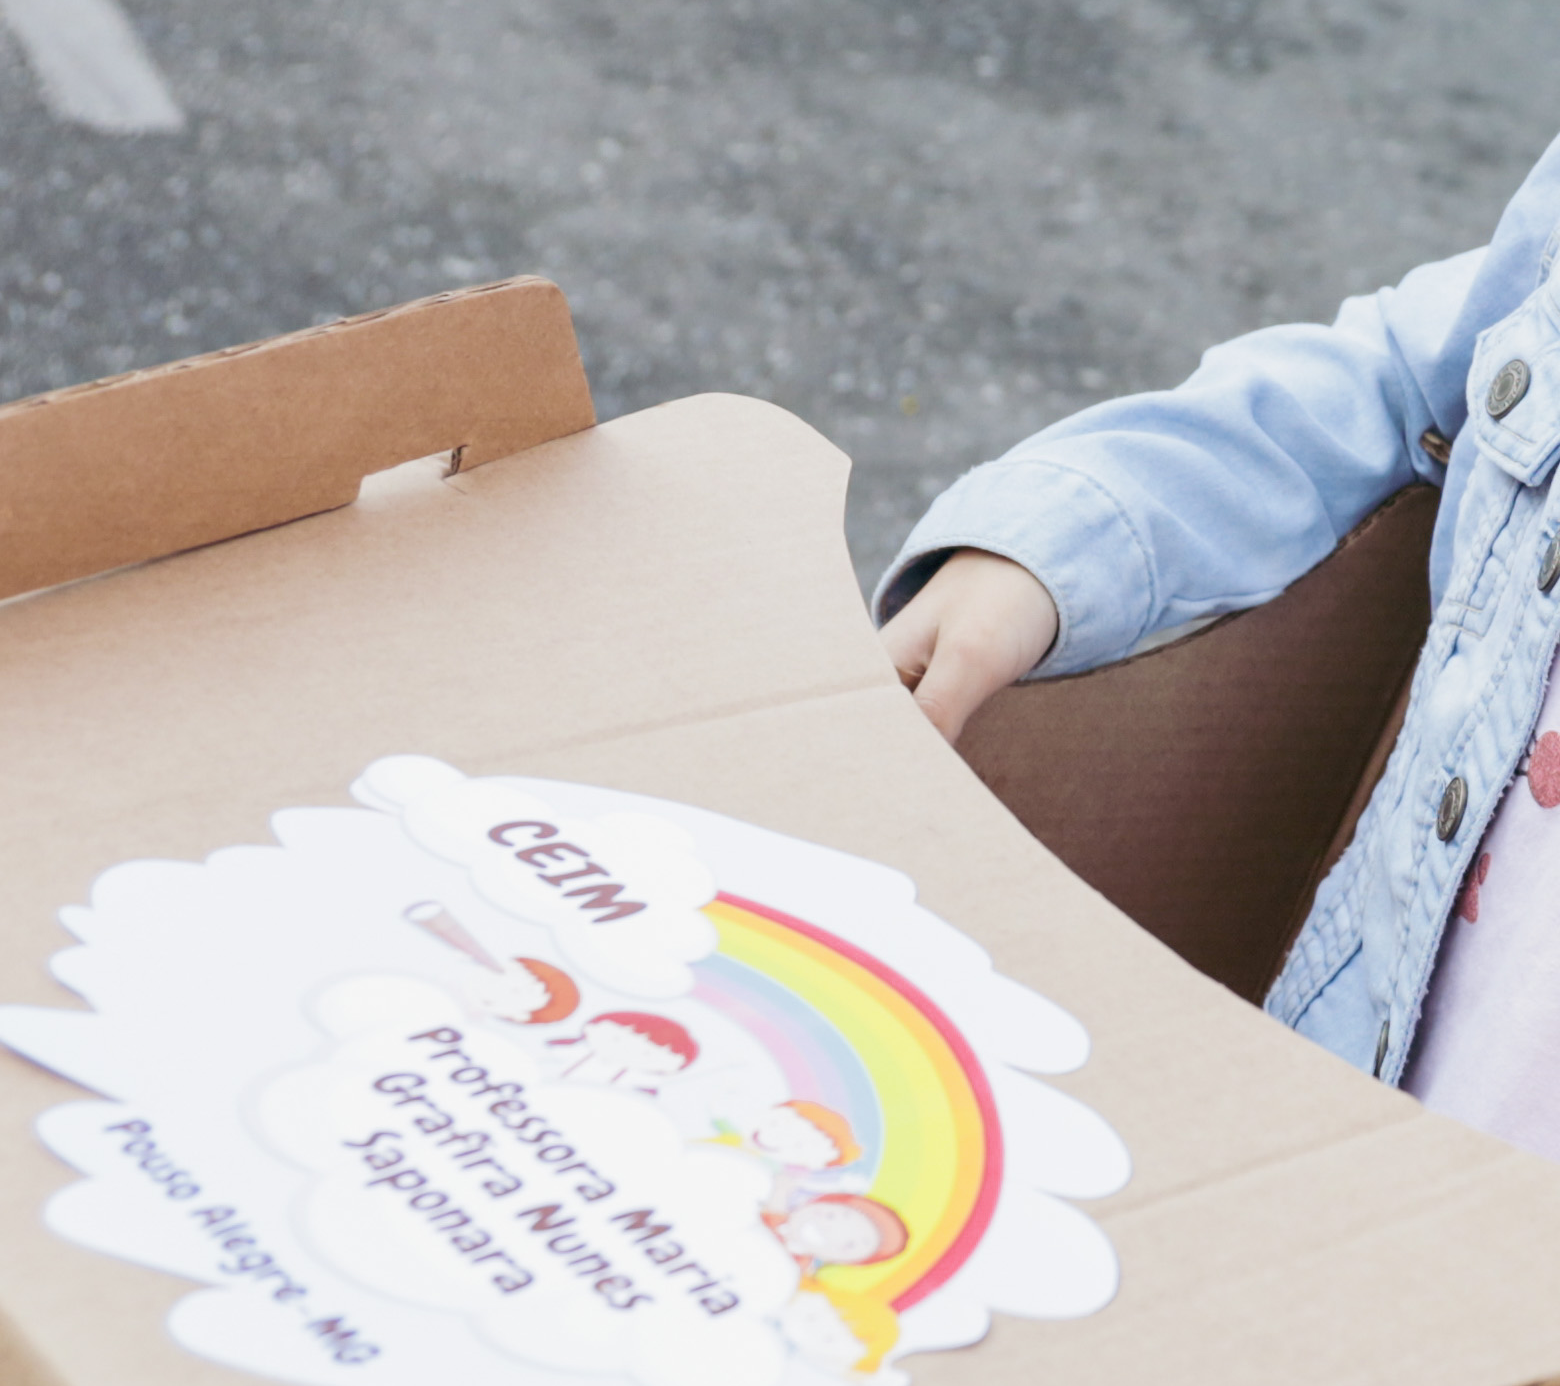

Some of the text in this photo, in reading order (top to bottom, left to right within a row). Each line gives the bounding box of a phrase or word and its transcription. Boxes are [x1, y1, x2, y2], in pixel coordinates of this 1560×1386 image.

[485, 817, 647, 925] CEIM
[103, 1119, 202, 1201] Pouso
[341, 1130, 534, 1294] Saponara
[372, 1072, 654, 1310] Grafira Nunes
[407, 1026, 740, 1316] Professora Maria
